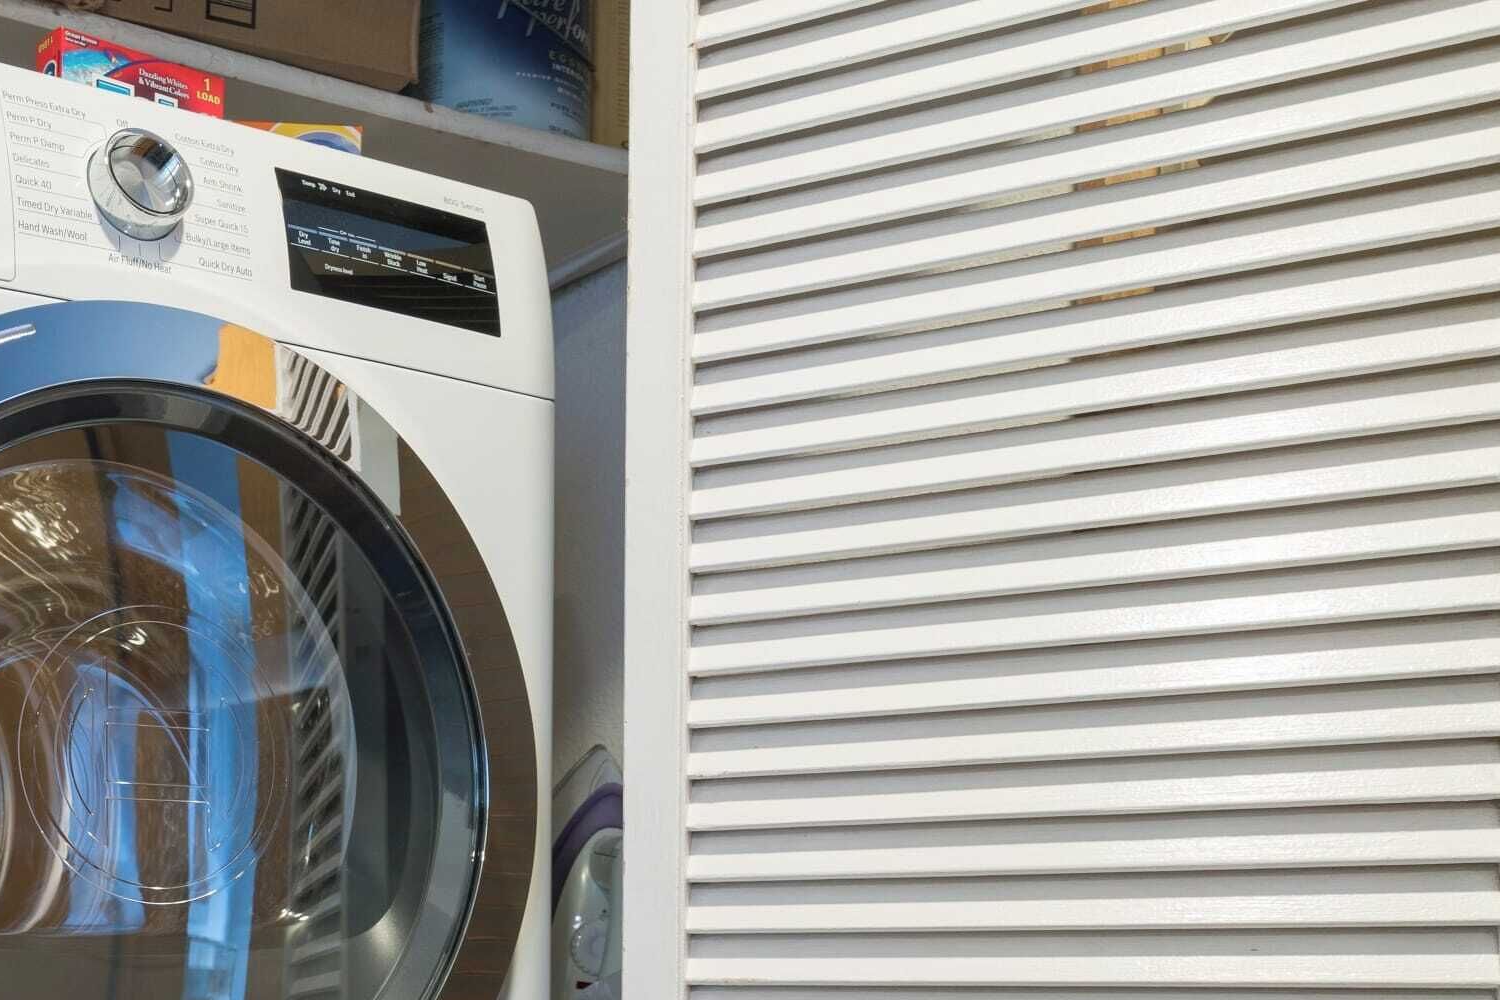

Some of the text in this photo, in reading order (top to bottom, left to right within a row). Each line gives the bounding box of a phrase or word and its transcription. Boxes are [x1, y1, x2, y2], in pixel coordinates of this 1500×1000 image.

[139, 68, 188, 90] Dazzling Whites
[204, 78, 212, 92] 1
[144, 78, 169, 93] Vibrant
[169, 86, 190, 100] Colors
[196, 91, 220, 105] LOAD
[2, 90, 24, 104] Perm
[49, 102, 70, 114] Extra
[70, 106, 86, 120] Dry
[6, 111, 28, 124] Perm
[36, 117, 51, 130] Dry
[10, 132, 32, 144] Perm
[12, 153, 50, 169] Delicates
[16, 174, 52, 190] Quick 40
[16, 197, 92, 220] Timed Dry Variable
[18, 220, 87, 241] Hand Wash/Wool
[108, 253, 121, 264] Air
[154, 260, 172, 274] Heat
[198, 257, 220, 272] Quick
[221, 262, 235, 276] Dry
